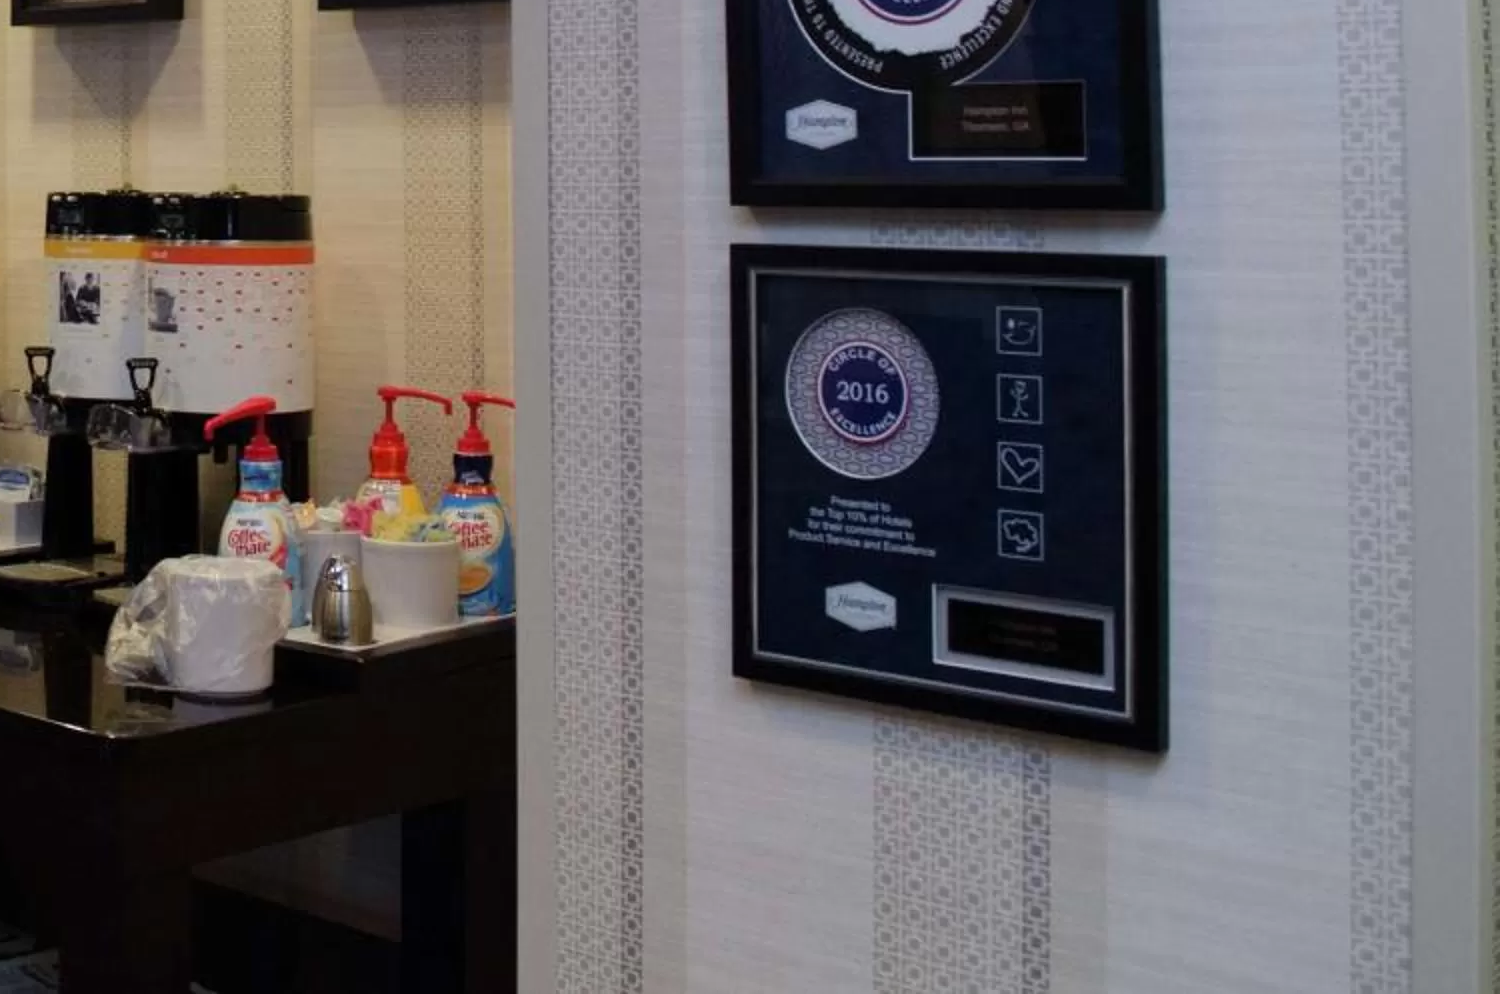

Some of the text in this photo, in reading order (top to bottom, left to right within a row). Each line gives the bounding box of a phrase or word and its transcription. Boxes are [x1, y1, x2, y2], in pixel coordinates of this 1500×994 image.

[811, 13, 828, 32] TO
[938, 15, 1003, 71] EXCELLENCE
[827, 349, 895, 374] CIRCLE OF
[835, 380, 891, 405] 2016
[829, 406, 896, 436] EXCELLENCE
[830, 495, 892, 513] Presented to
[808, 506, 913, 529] the Top 10% of Hotels
[807, 518, 916, 542] for their commitment to
[863, 537, 881, 550] and
[882, 540, 937, 558] Excellence
